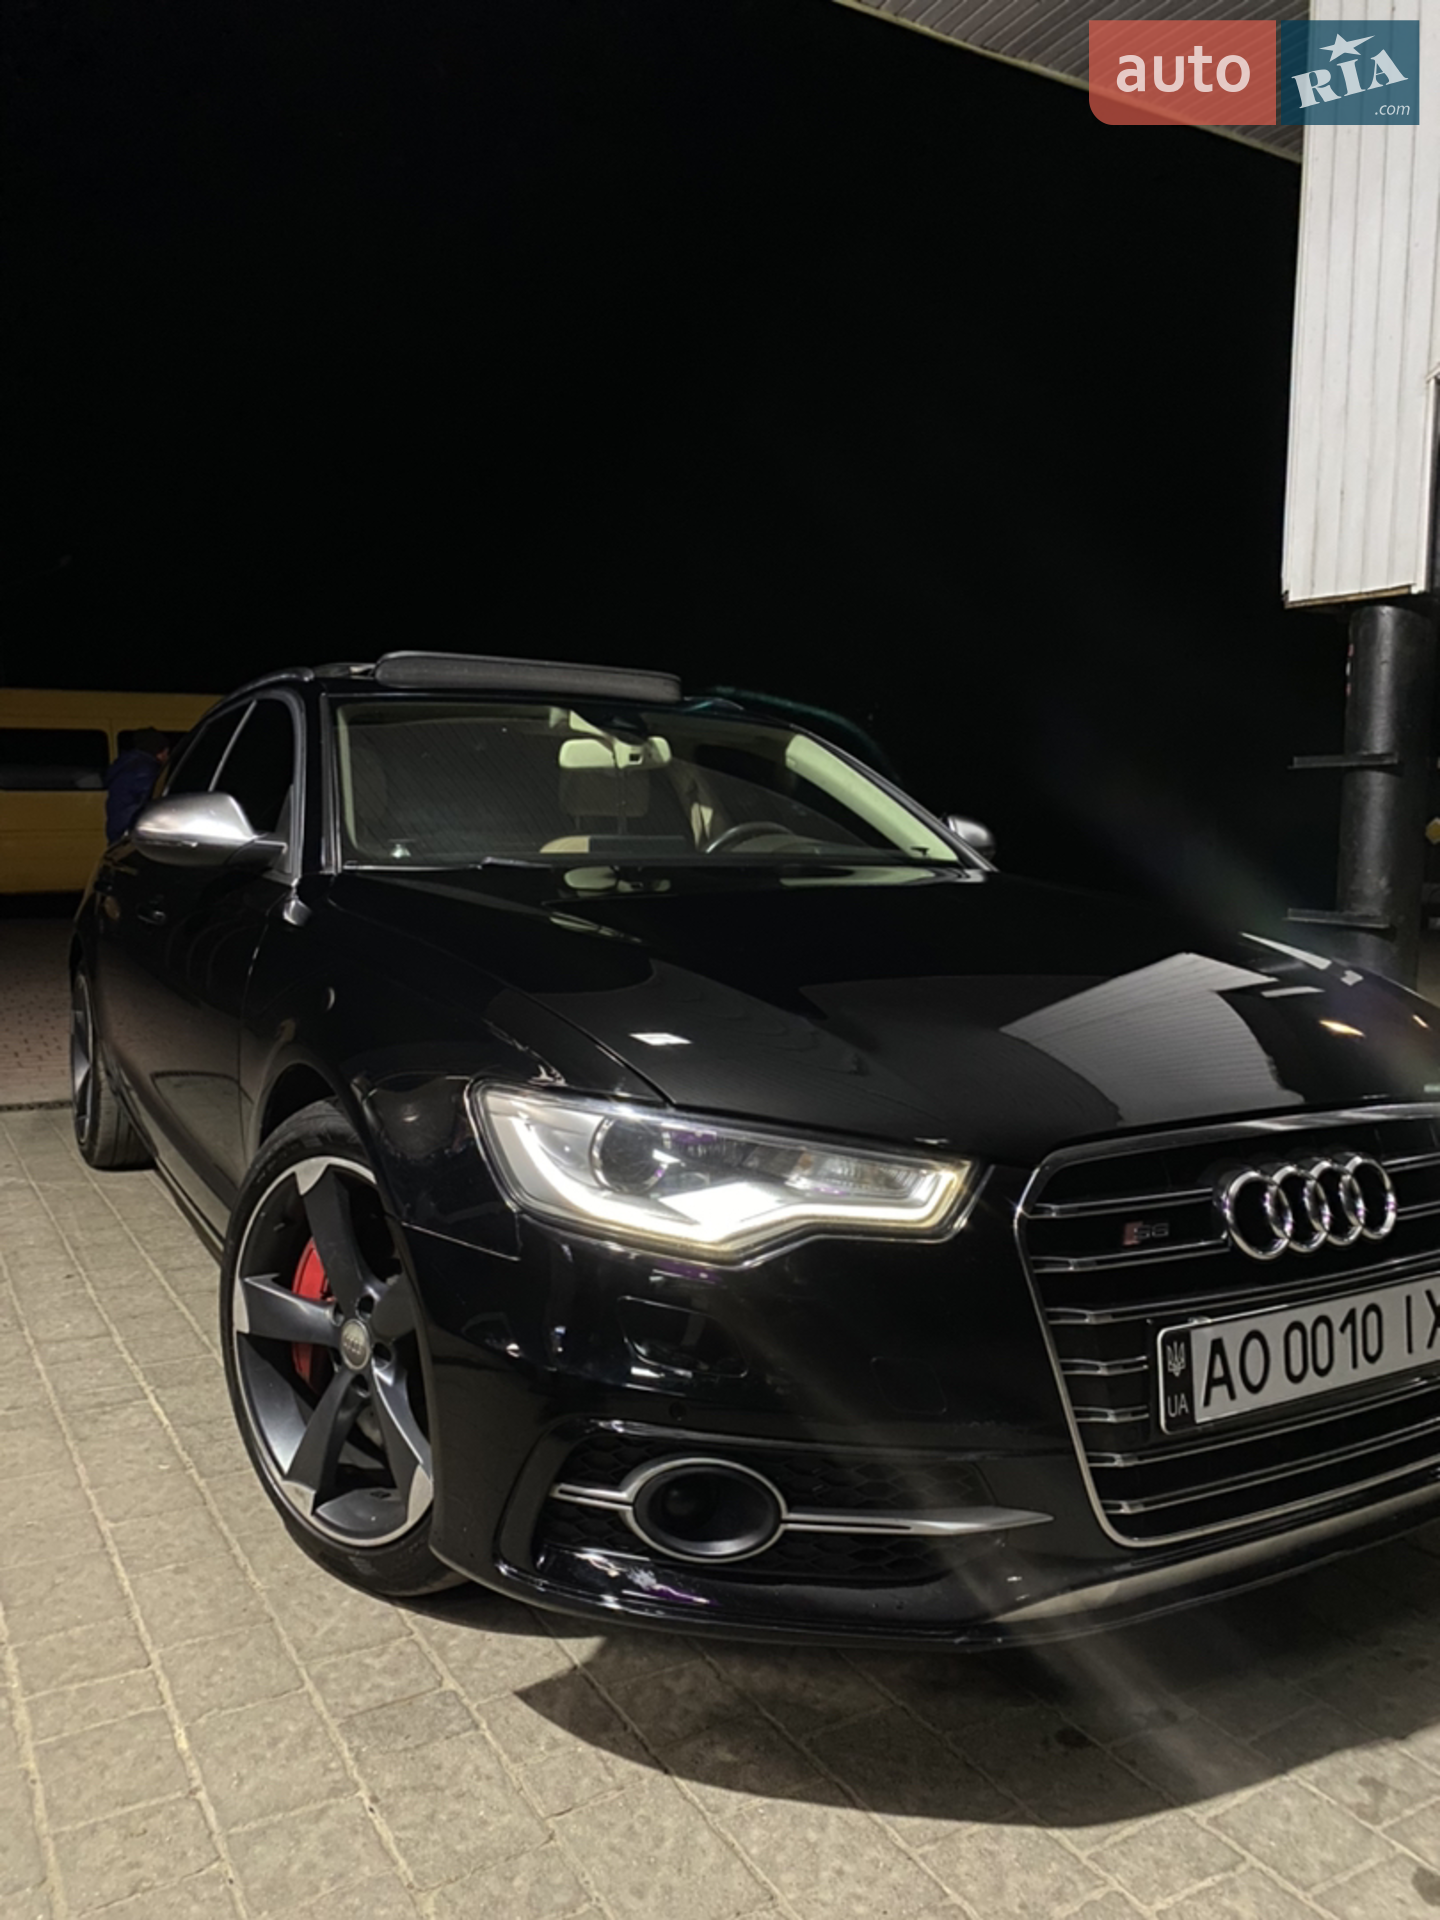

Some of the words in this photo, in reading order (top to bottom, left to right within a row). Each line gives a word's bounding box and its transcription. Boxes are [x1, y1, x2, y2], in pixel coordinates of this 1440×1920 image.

[1203, 1329, 1270, 1408] AO
[1283, 1302, 1383, 1384] 0010
[1167, 1393, 1189, 1418] UA
